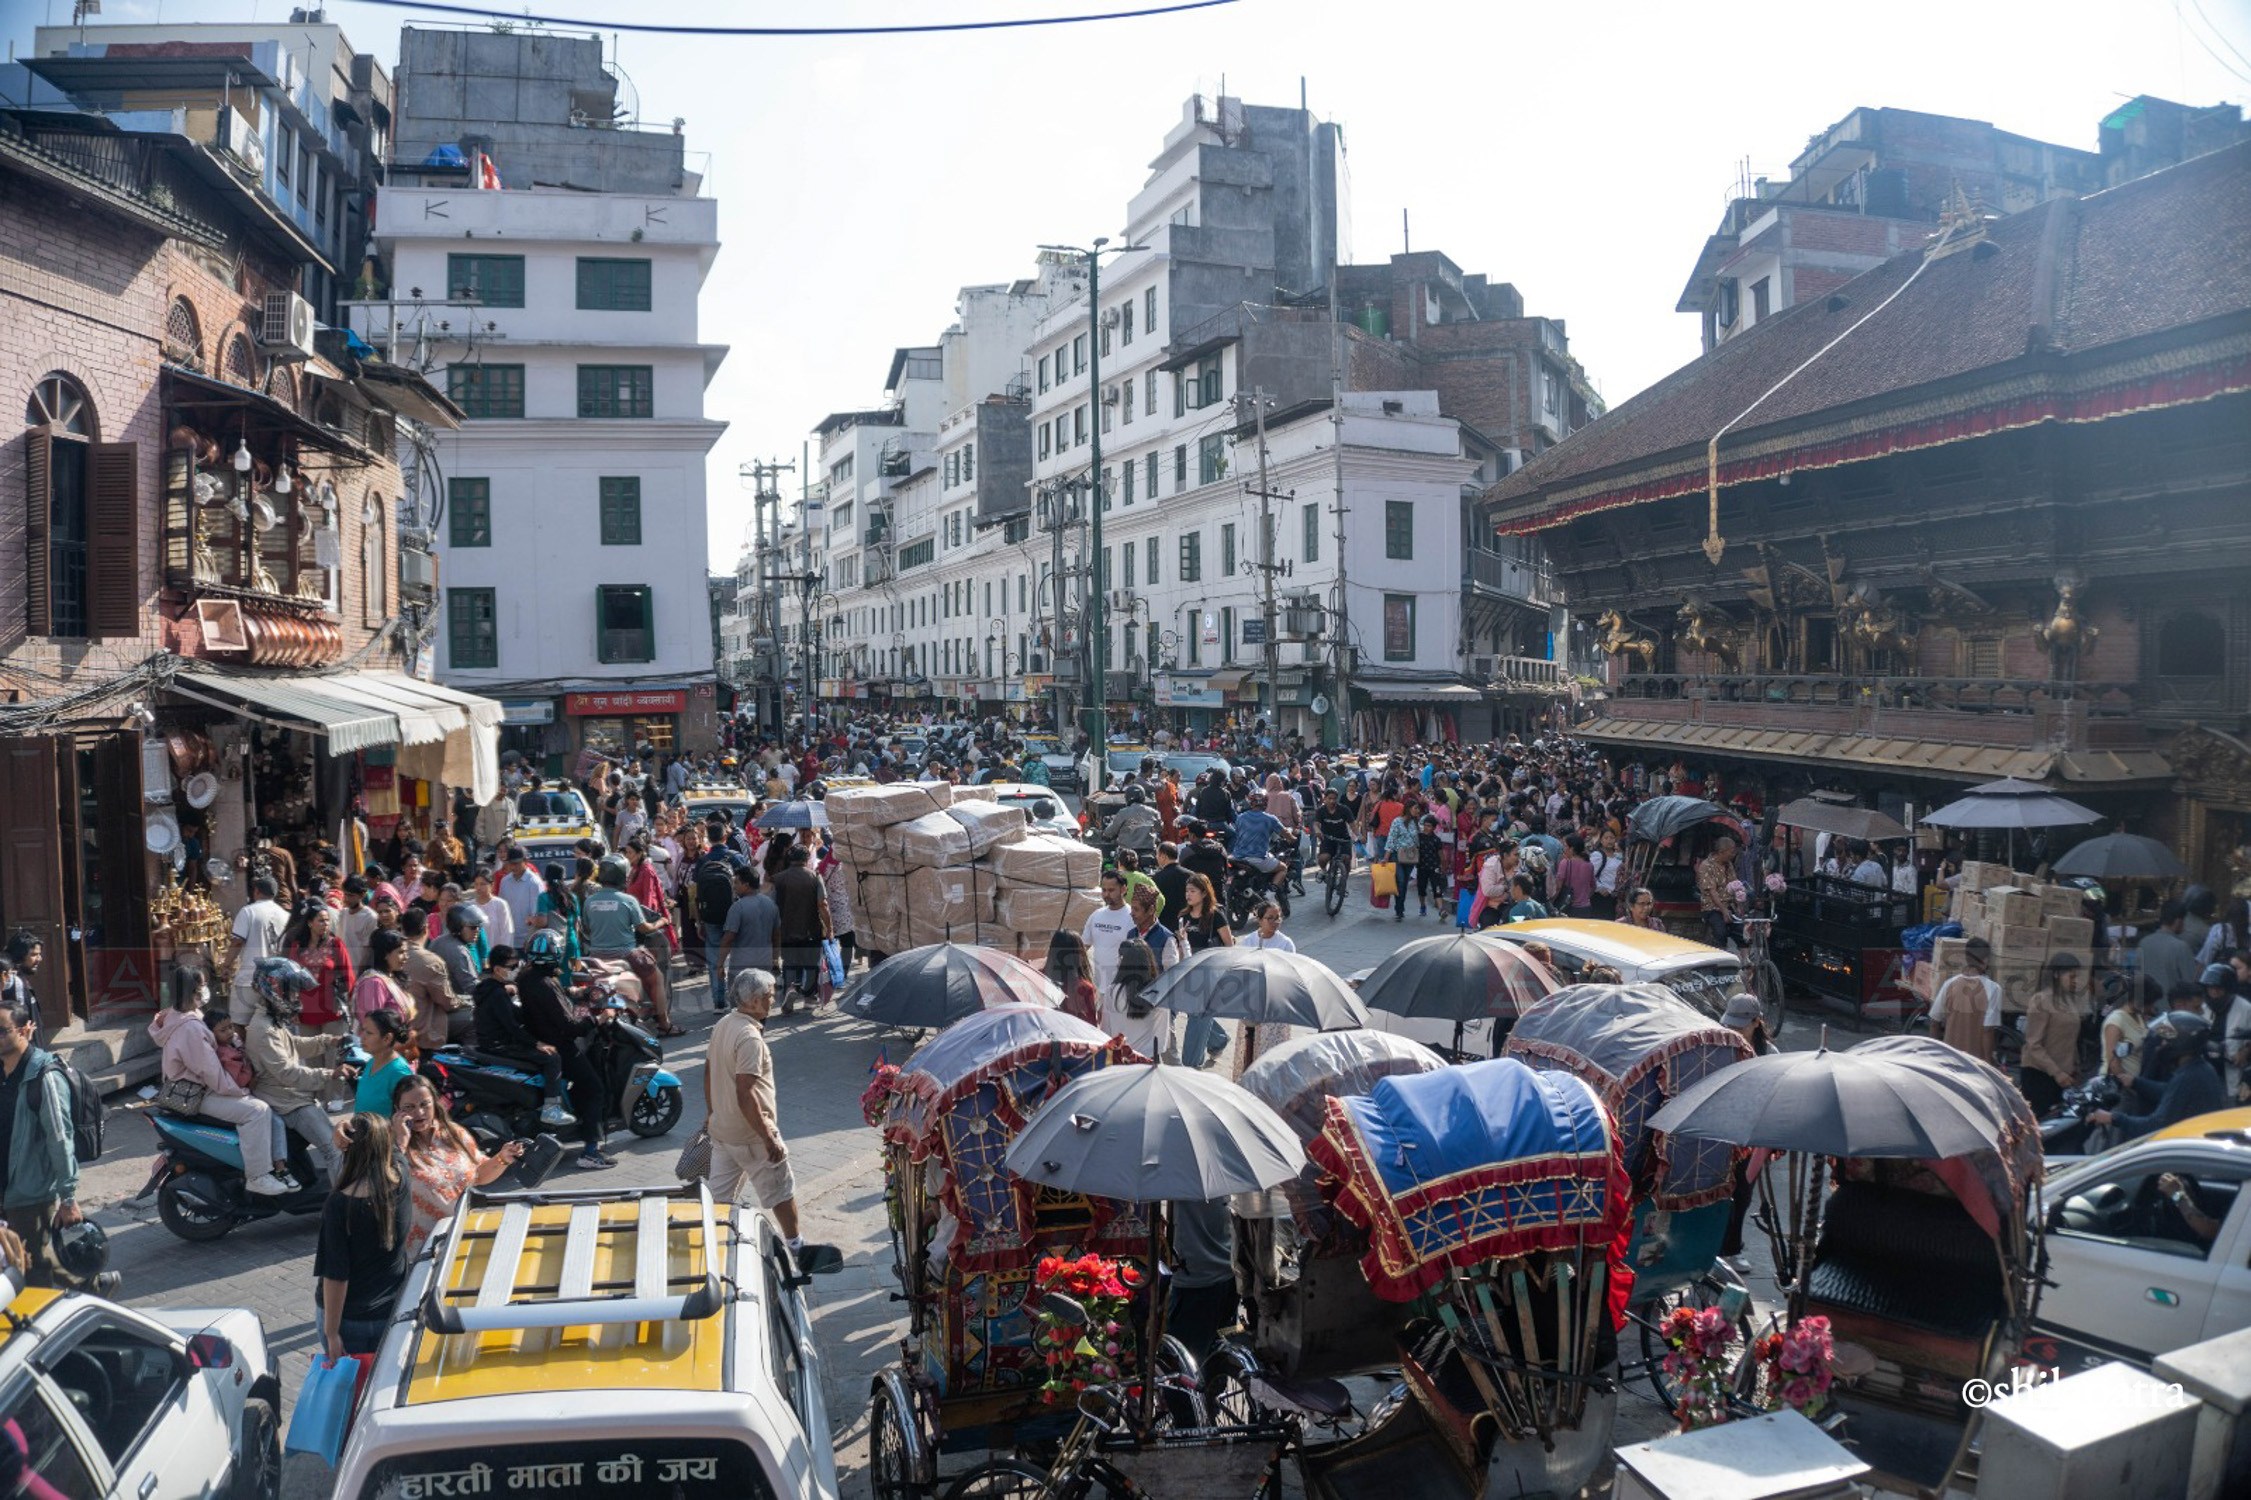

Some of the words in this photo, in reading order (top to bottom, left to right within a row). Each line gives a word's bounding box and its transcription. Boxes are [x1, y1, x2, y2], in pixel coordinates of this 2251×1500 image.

[400, 1461, 494, 1500] हारती
[507, 1462, 584, 1489] माता
[596, 1453, 644, 1484] की
[656, 1456, 719, 1483] जय
